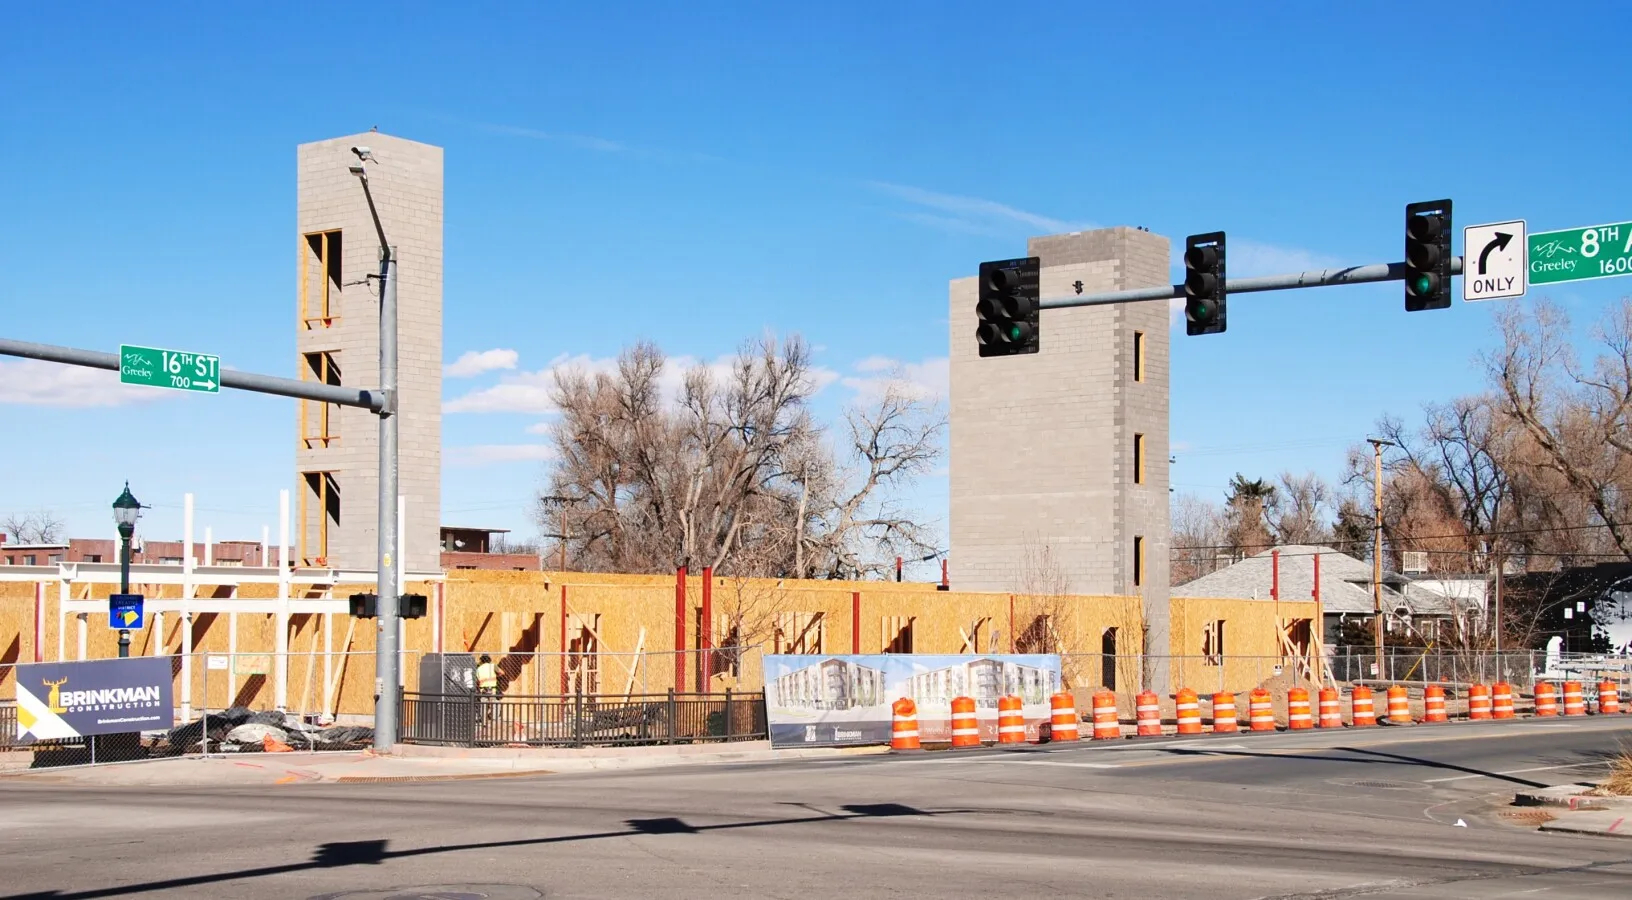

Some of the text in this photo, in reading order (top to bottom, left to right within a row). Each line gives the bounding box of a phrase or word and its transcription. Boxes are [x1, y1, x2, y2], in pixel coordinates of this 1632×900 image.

[1580, 226, 1619, 258] 8TH
[1531, 258, 1578, 273] Greeley
[1473, 276, 1515, 294] ONLY
[122, 365, 154, 380] Greeley
[161, 351, 218, 378] 16TH ST
[170, 375, 191, 389] 700
[60, 686, 160, 707] BRINKMAN
[69, 700, 160, 713] CONSTRUCTION
